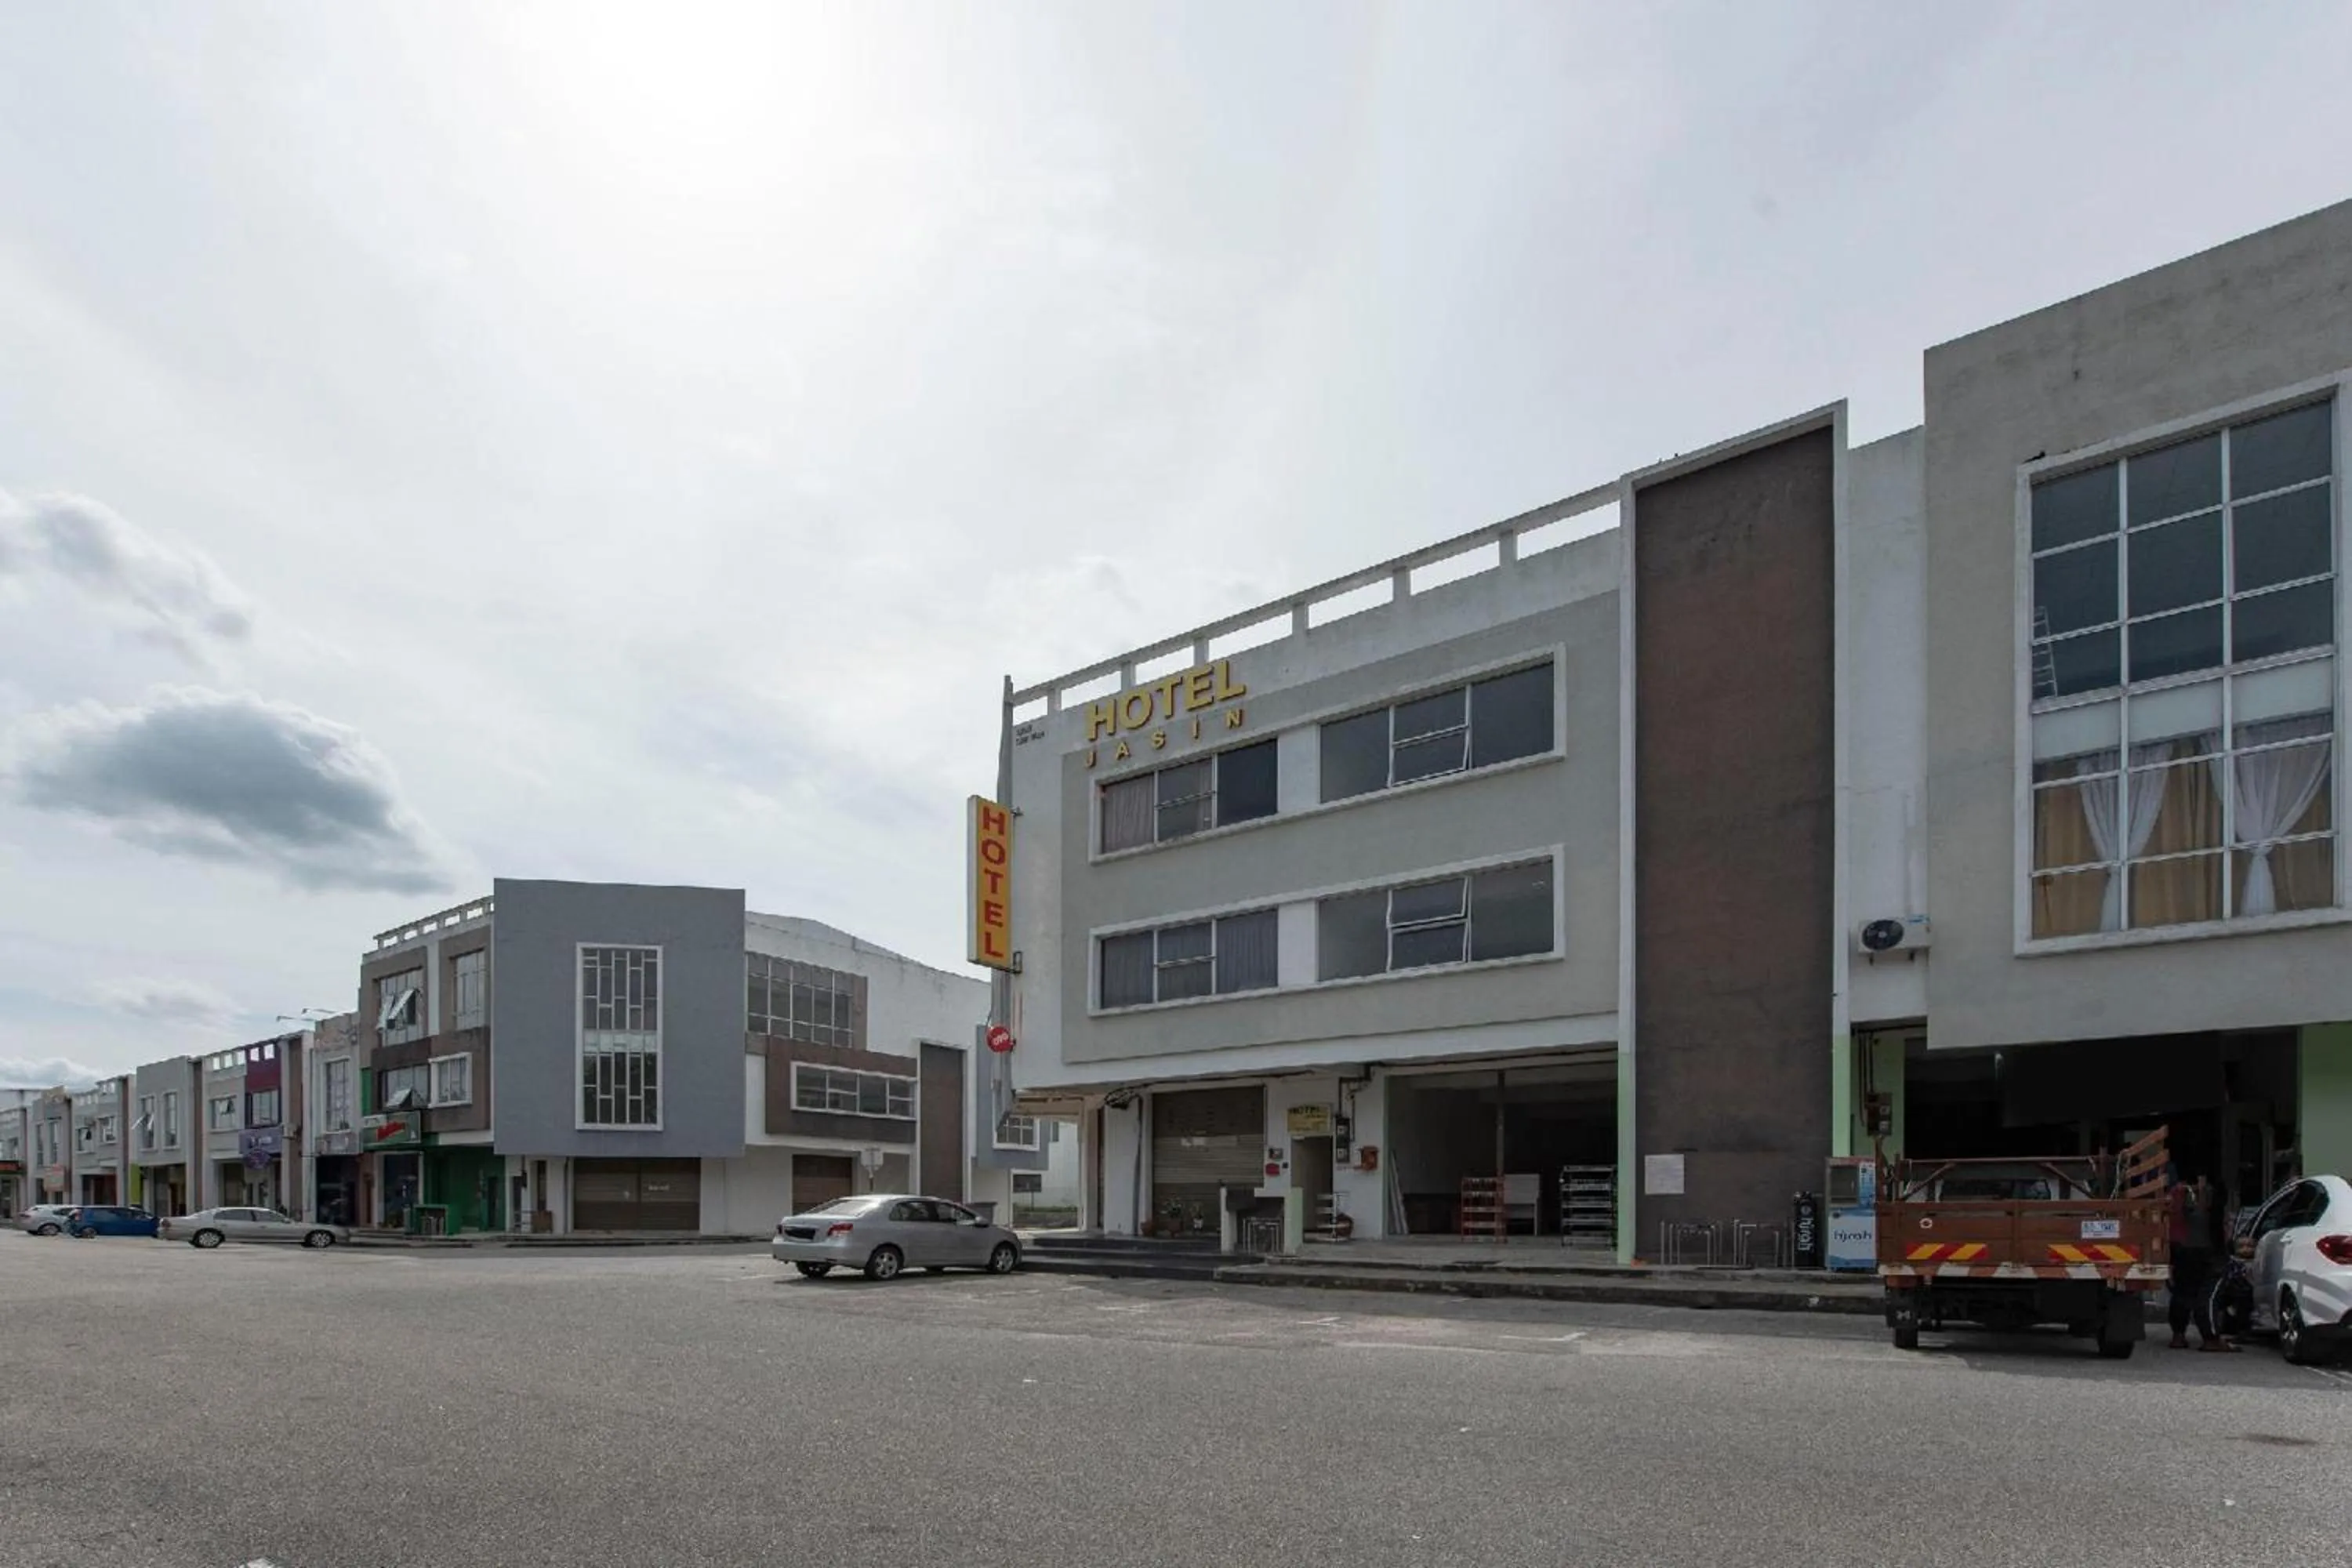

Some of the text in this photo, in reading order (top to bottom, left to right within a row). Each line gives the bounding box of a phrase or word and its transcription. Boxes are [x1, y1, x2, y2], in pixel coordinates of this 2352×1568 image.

[1085, 709, 1243, 768] JASIN
[1087, 659, 1247, 742] HOTEL
[981, 805, 1006, 958] HOTEL
